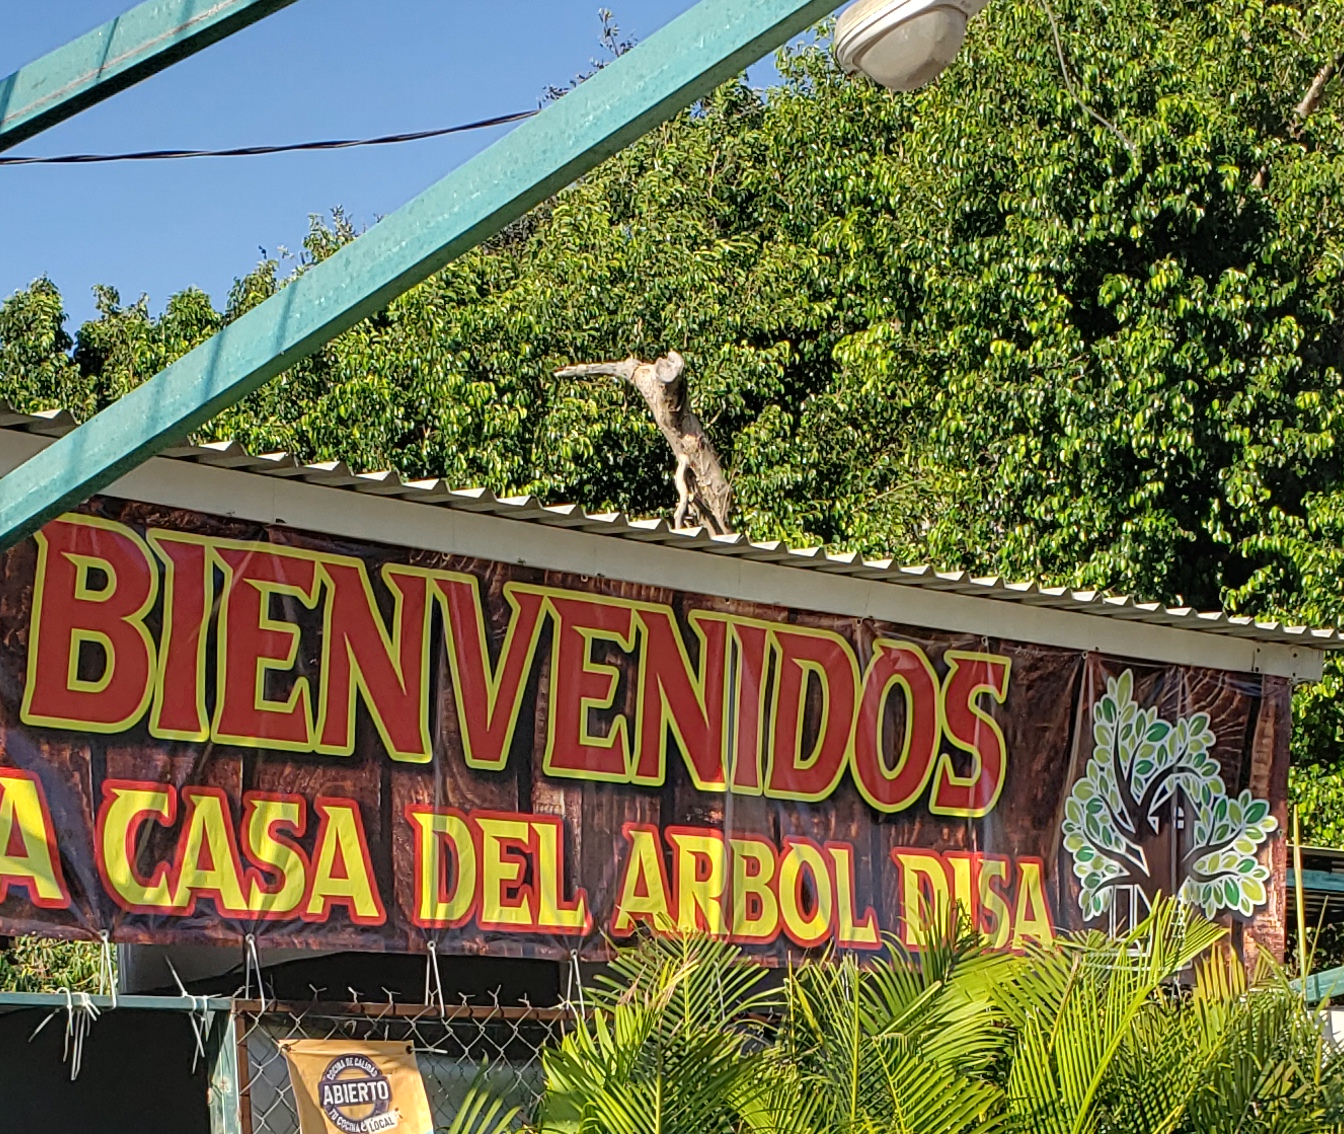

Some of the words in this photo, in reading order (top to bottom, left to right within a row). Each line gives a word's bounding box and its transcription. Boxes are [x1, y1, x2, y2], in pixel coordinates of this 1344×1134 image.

[20, 512, 1012, 818] BIENVENIDOS
[96, 779, 387, 923] CASA
[406, 804, 592, 936] DEL
[610, 822, 883, 950] ARBOL
[891, 847, 1057, 956] DISA
[323, 1081, 389, 1105] ABIERTO
[368, 1116, 396, 1132] LOCAL
